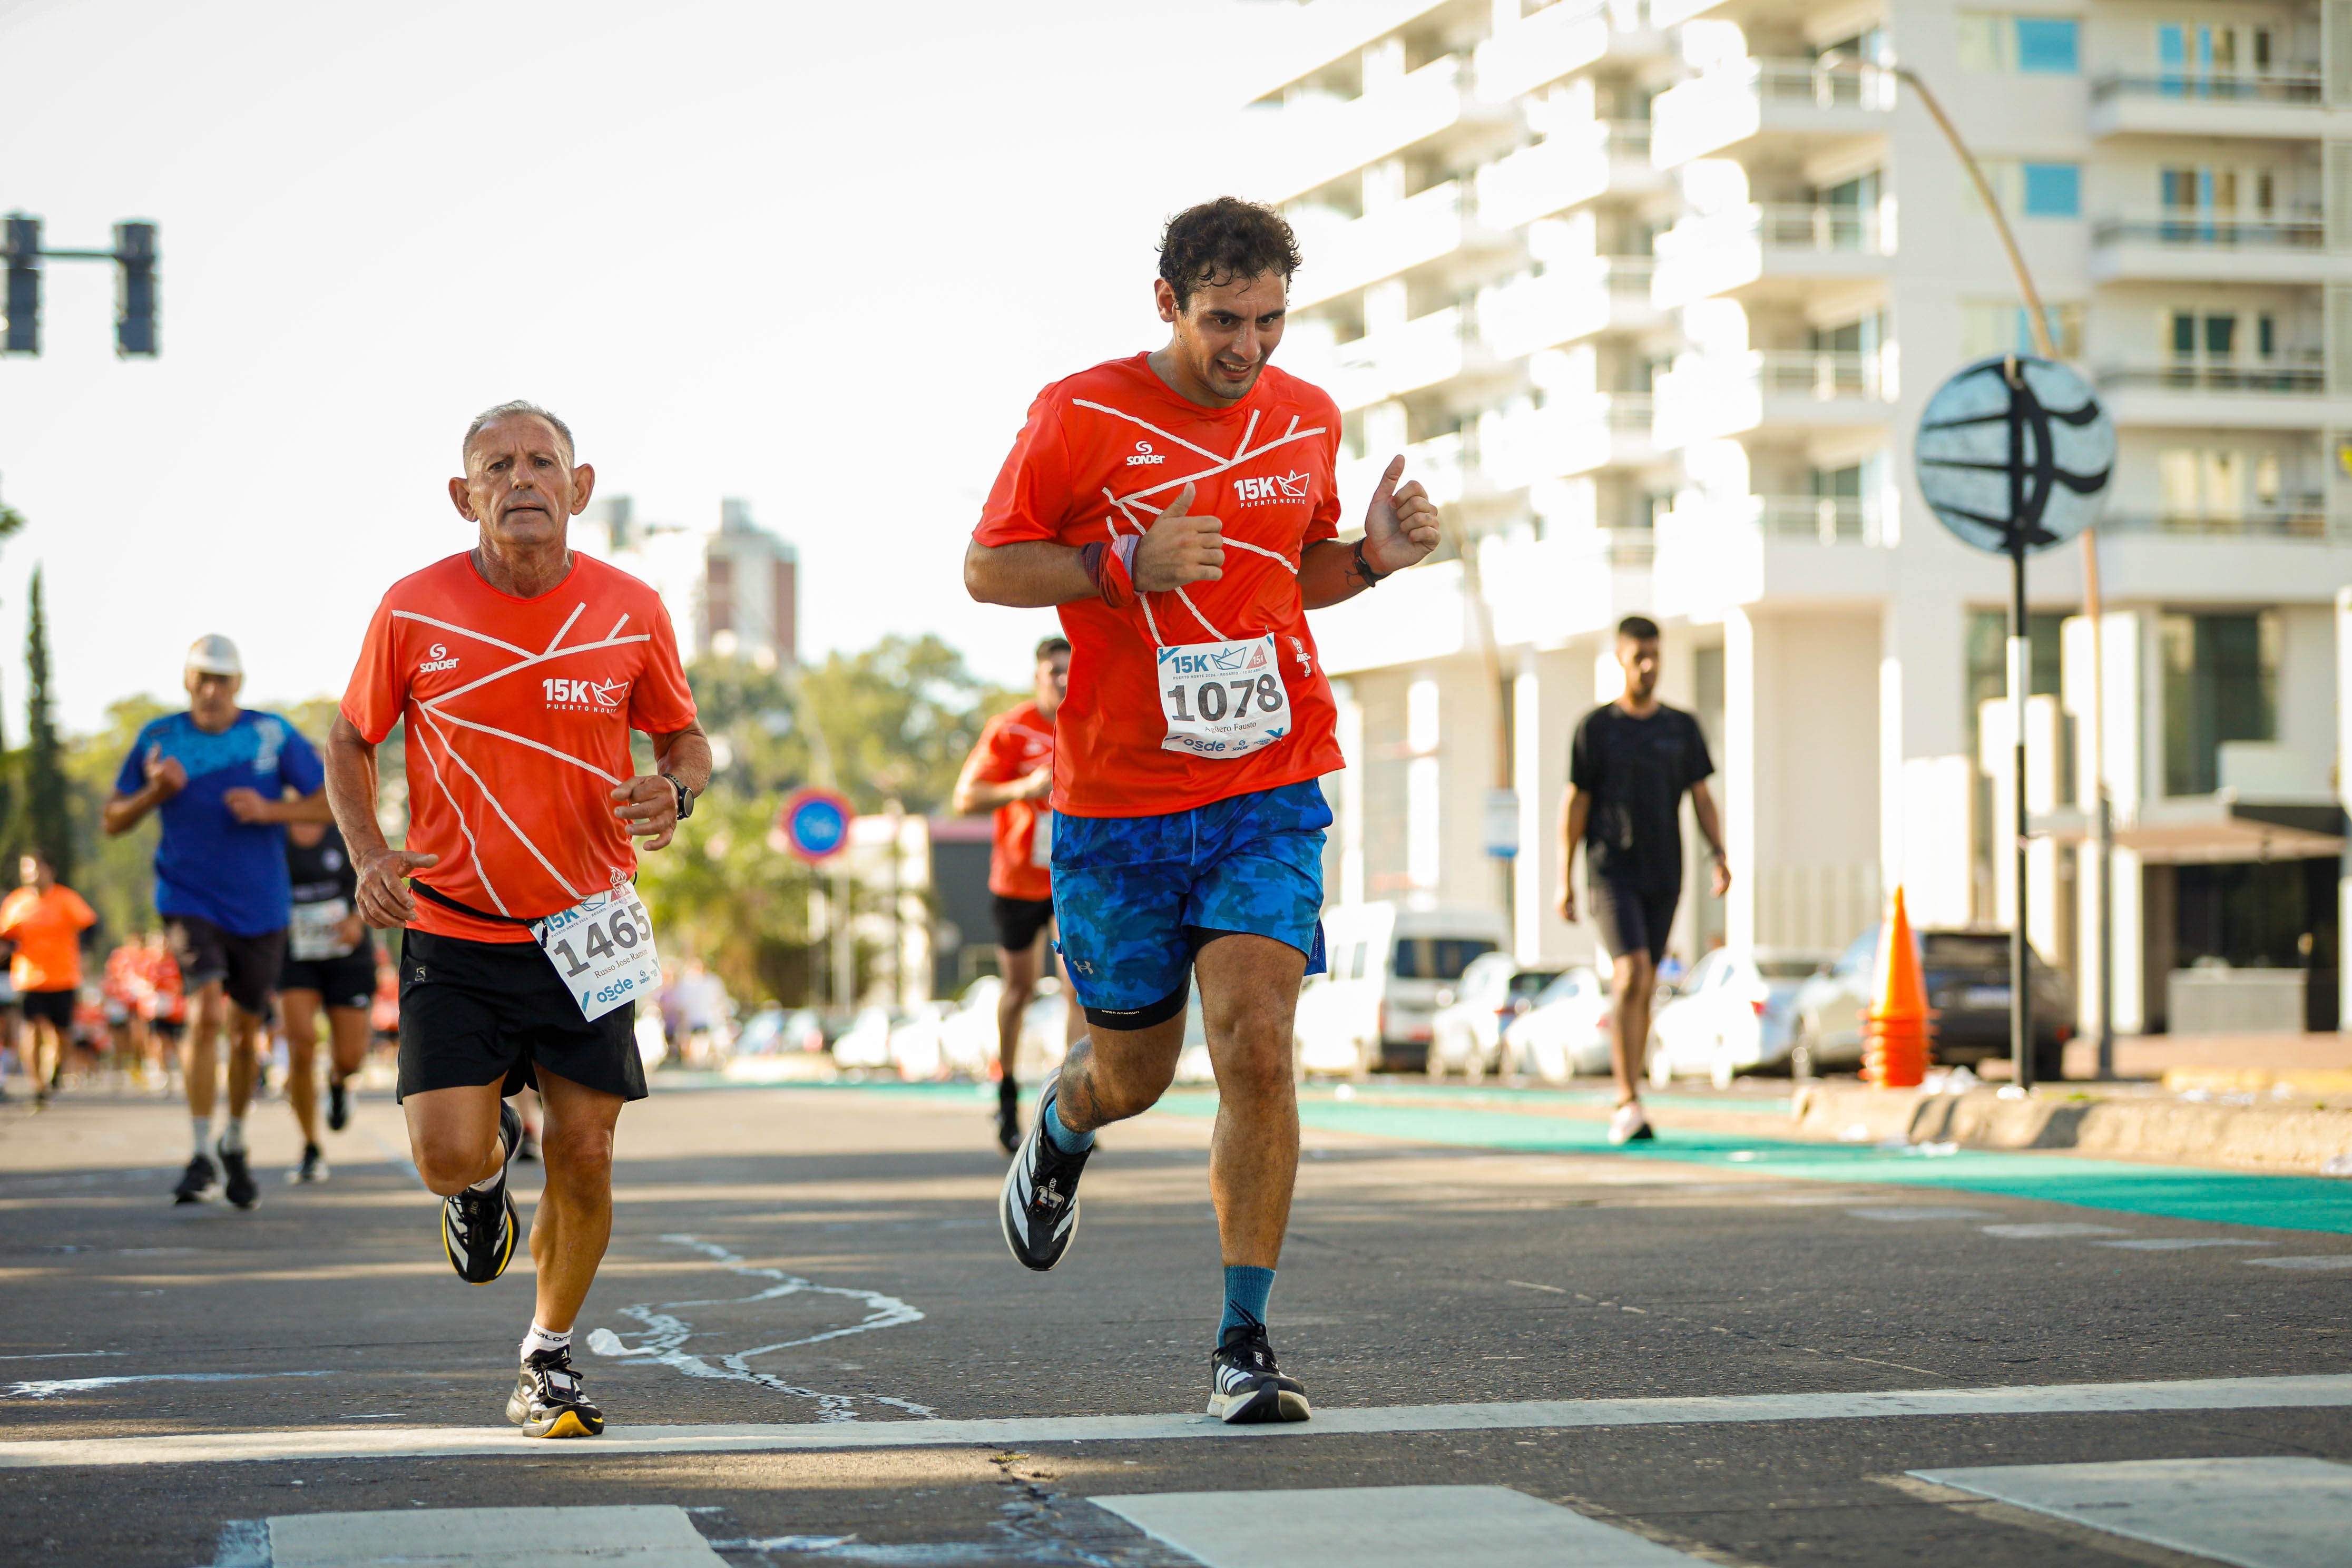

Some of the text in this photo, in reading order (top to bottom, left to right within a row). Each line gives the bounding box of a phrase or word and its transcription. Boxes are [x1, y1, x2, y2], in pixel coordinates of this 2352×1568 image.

[1233, 476, 1277, 501] 15K
[1240, 498, 1276, 508] PUERTO
[1172, 654, 1209, 674] 15K
[1252, 654, 1264, 665] 15K
[543, 678, 589, 703] 15K
[1168, 674, 1283, 722] 1078
[1234, 722, 1257, 731] Fausto
[1183, 739, 1226, 751] osde
[553, 901, 650, 977] 1465
[594, 965, 615, 978] Russo
[615, 957, 631, 968] Jose
[596, 978, 633, 1003] osde
